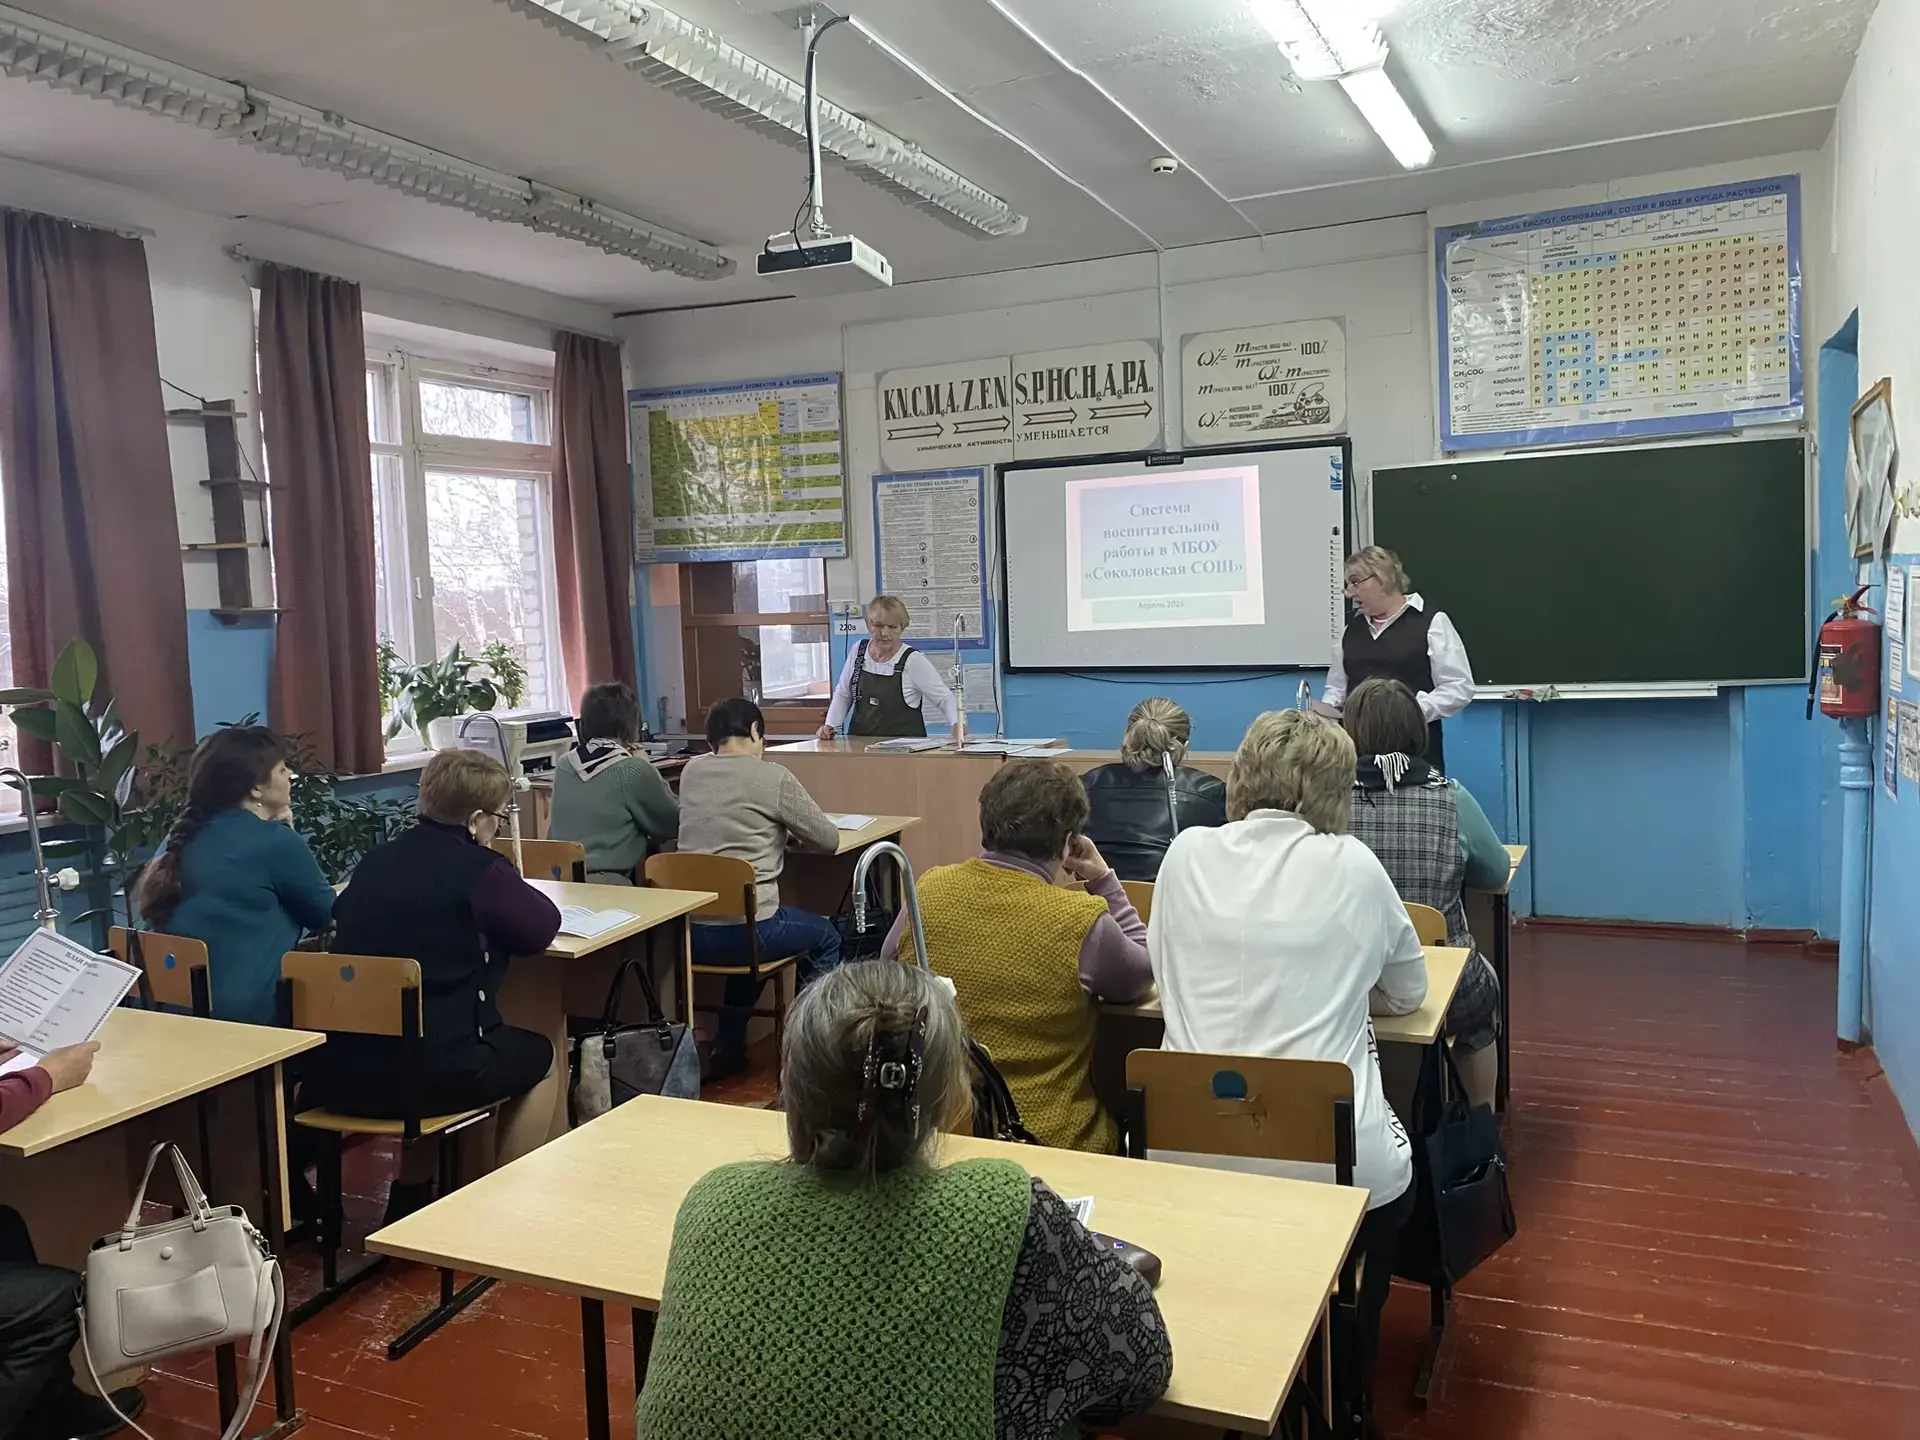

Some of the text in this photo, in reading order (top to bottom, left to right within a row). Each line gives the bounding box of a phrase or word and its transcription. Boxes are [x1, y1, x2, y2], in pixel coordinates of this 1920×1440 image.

[1658, 198, 1682, 208] ВОДЕ
[1685, 196, 1692, 204] И
[1694, 192, 1724, 203] СРЕДА
[1726, 184, 1782, 199] РАСТВОРОВ
[1016, 425, 1109, 442] УМЕНЬШАЕТСЯ
[917, 438, 1013, 452] ХИМИЧЕСКАЯ АКТИВНОСТЬ
[1129, 504, 1191, 517] Система
[1103, 520, 1220, 539] воспитательной
[1103, 539, 1222, 562] работы в МБОУ
[1085, 559, 1243, 580] «Соколовская СОШ»
